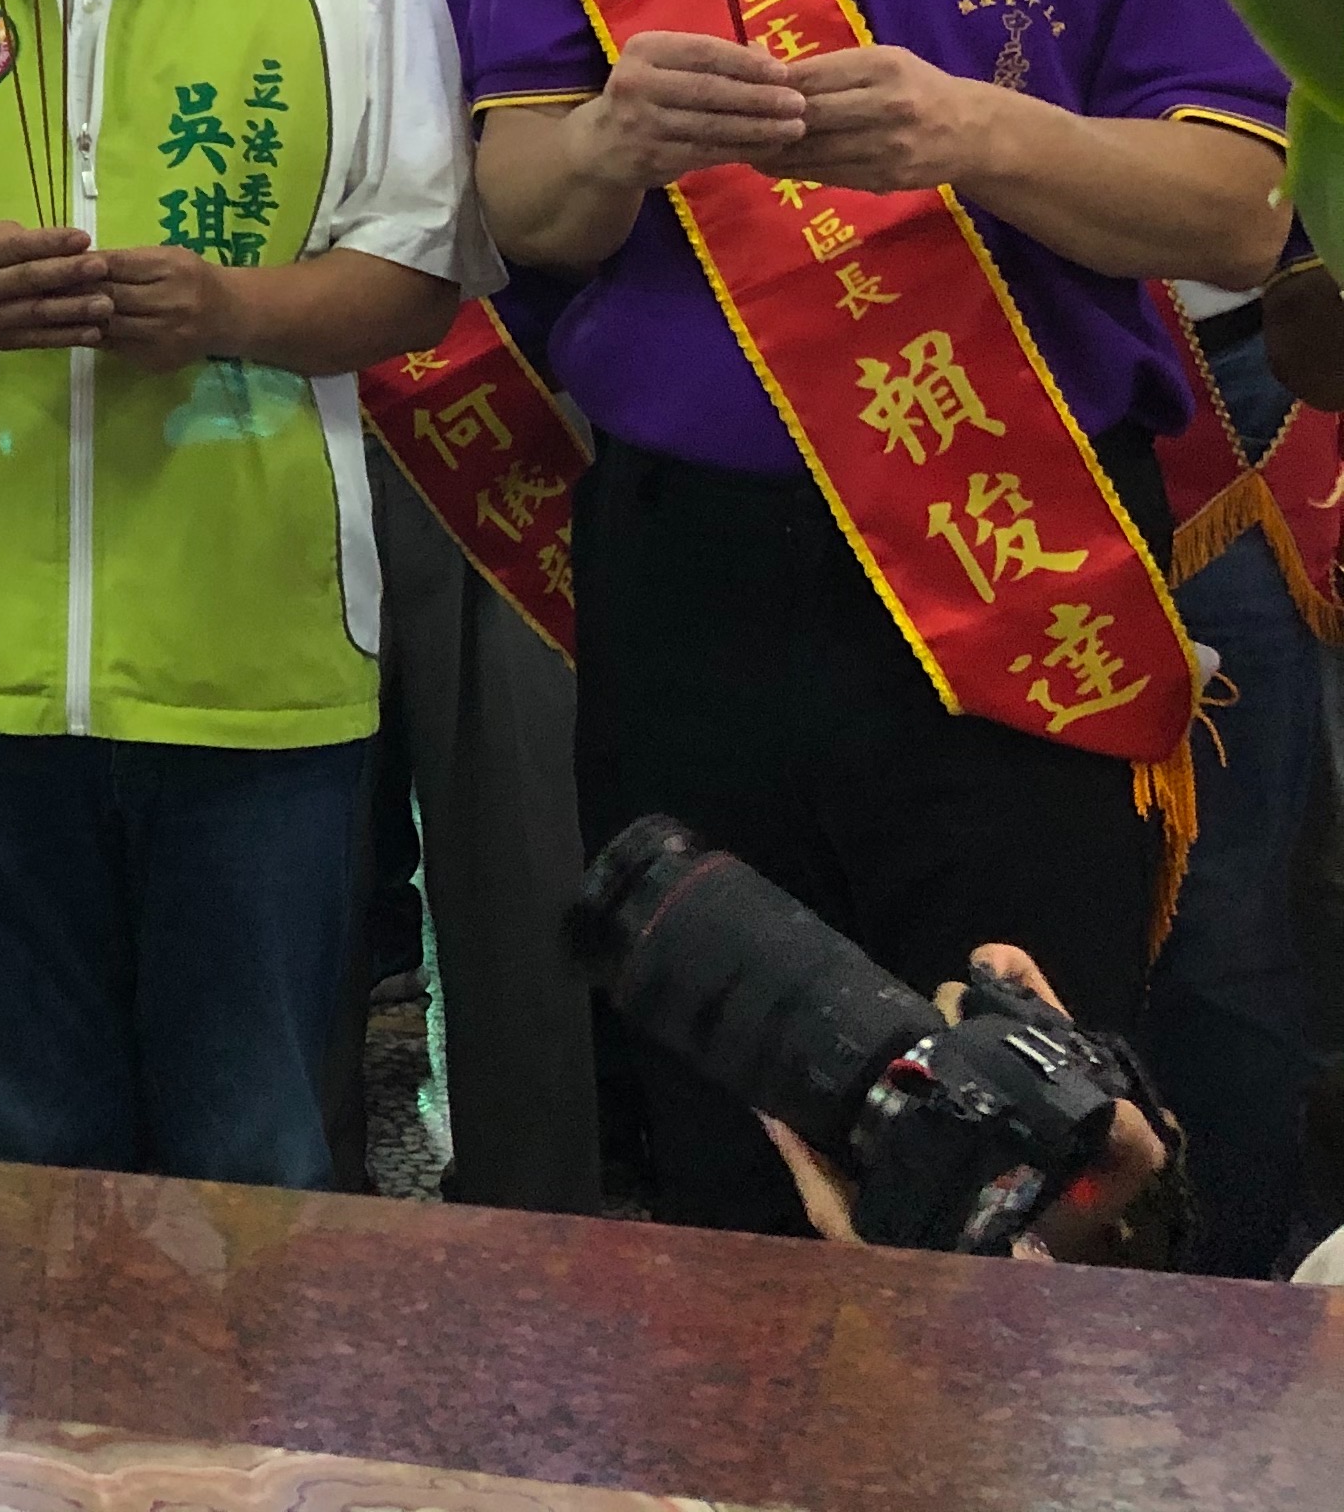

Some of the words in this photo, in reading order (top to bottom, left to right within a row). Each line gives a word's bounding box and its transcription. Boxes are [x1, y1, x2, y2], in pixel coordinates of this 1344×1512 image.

[231, 59, 289, 267] 立法委員
[400, 349, 450, 381] 長
[855, 330, 1152, 734] 賴俊達
